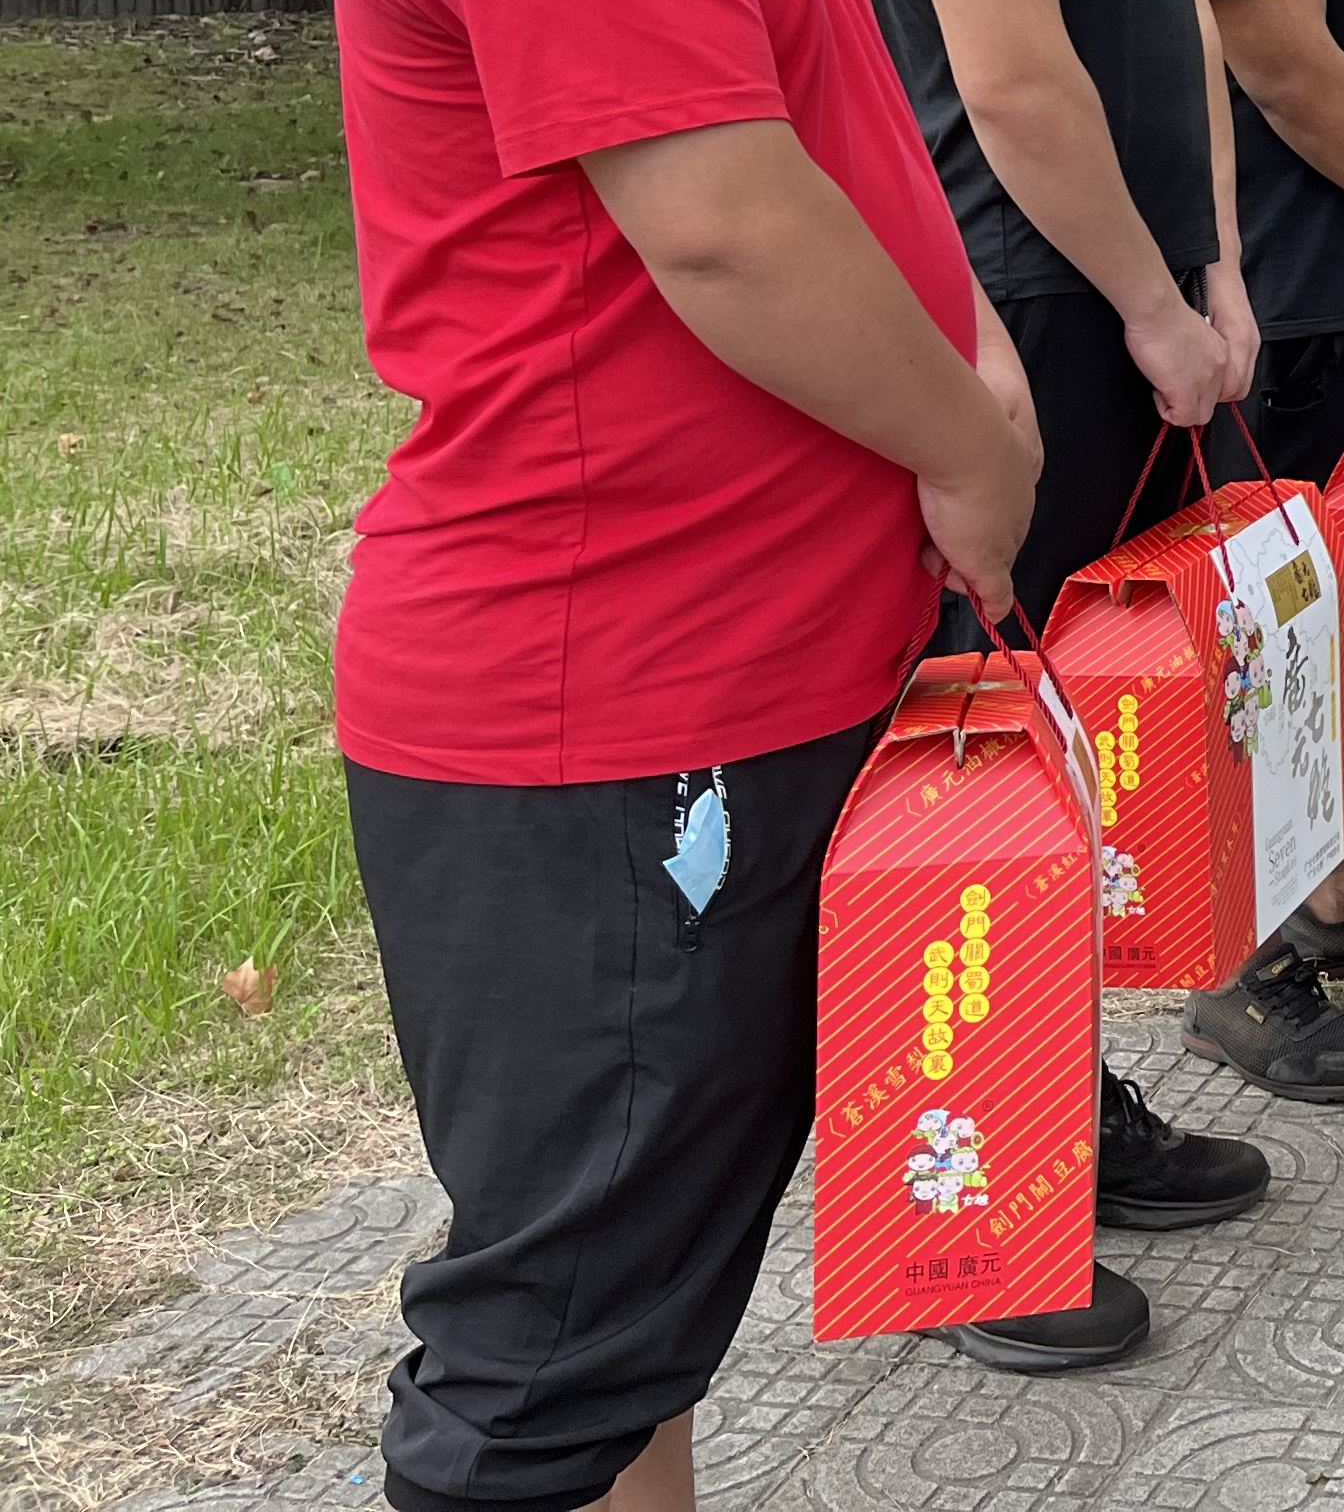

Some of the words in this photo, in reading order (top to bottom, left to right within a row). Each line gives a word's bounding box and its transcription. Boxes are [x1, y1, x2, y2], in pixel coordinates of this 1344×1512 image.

[1269, 836, 1297, 874] Seven
[1103, 946, 1122, 961] 國
[1127, 946, 1156, 961] 廣元
[906, 1258, 948, 1283] 中國
[958, 1252, 1001, 1278] 廣元
[905, 1281, 969, 1296] GUANGYUAN
[971, 1277, 1001, 1289] CHINA
